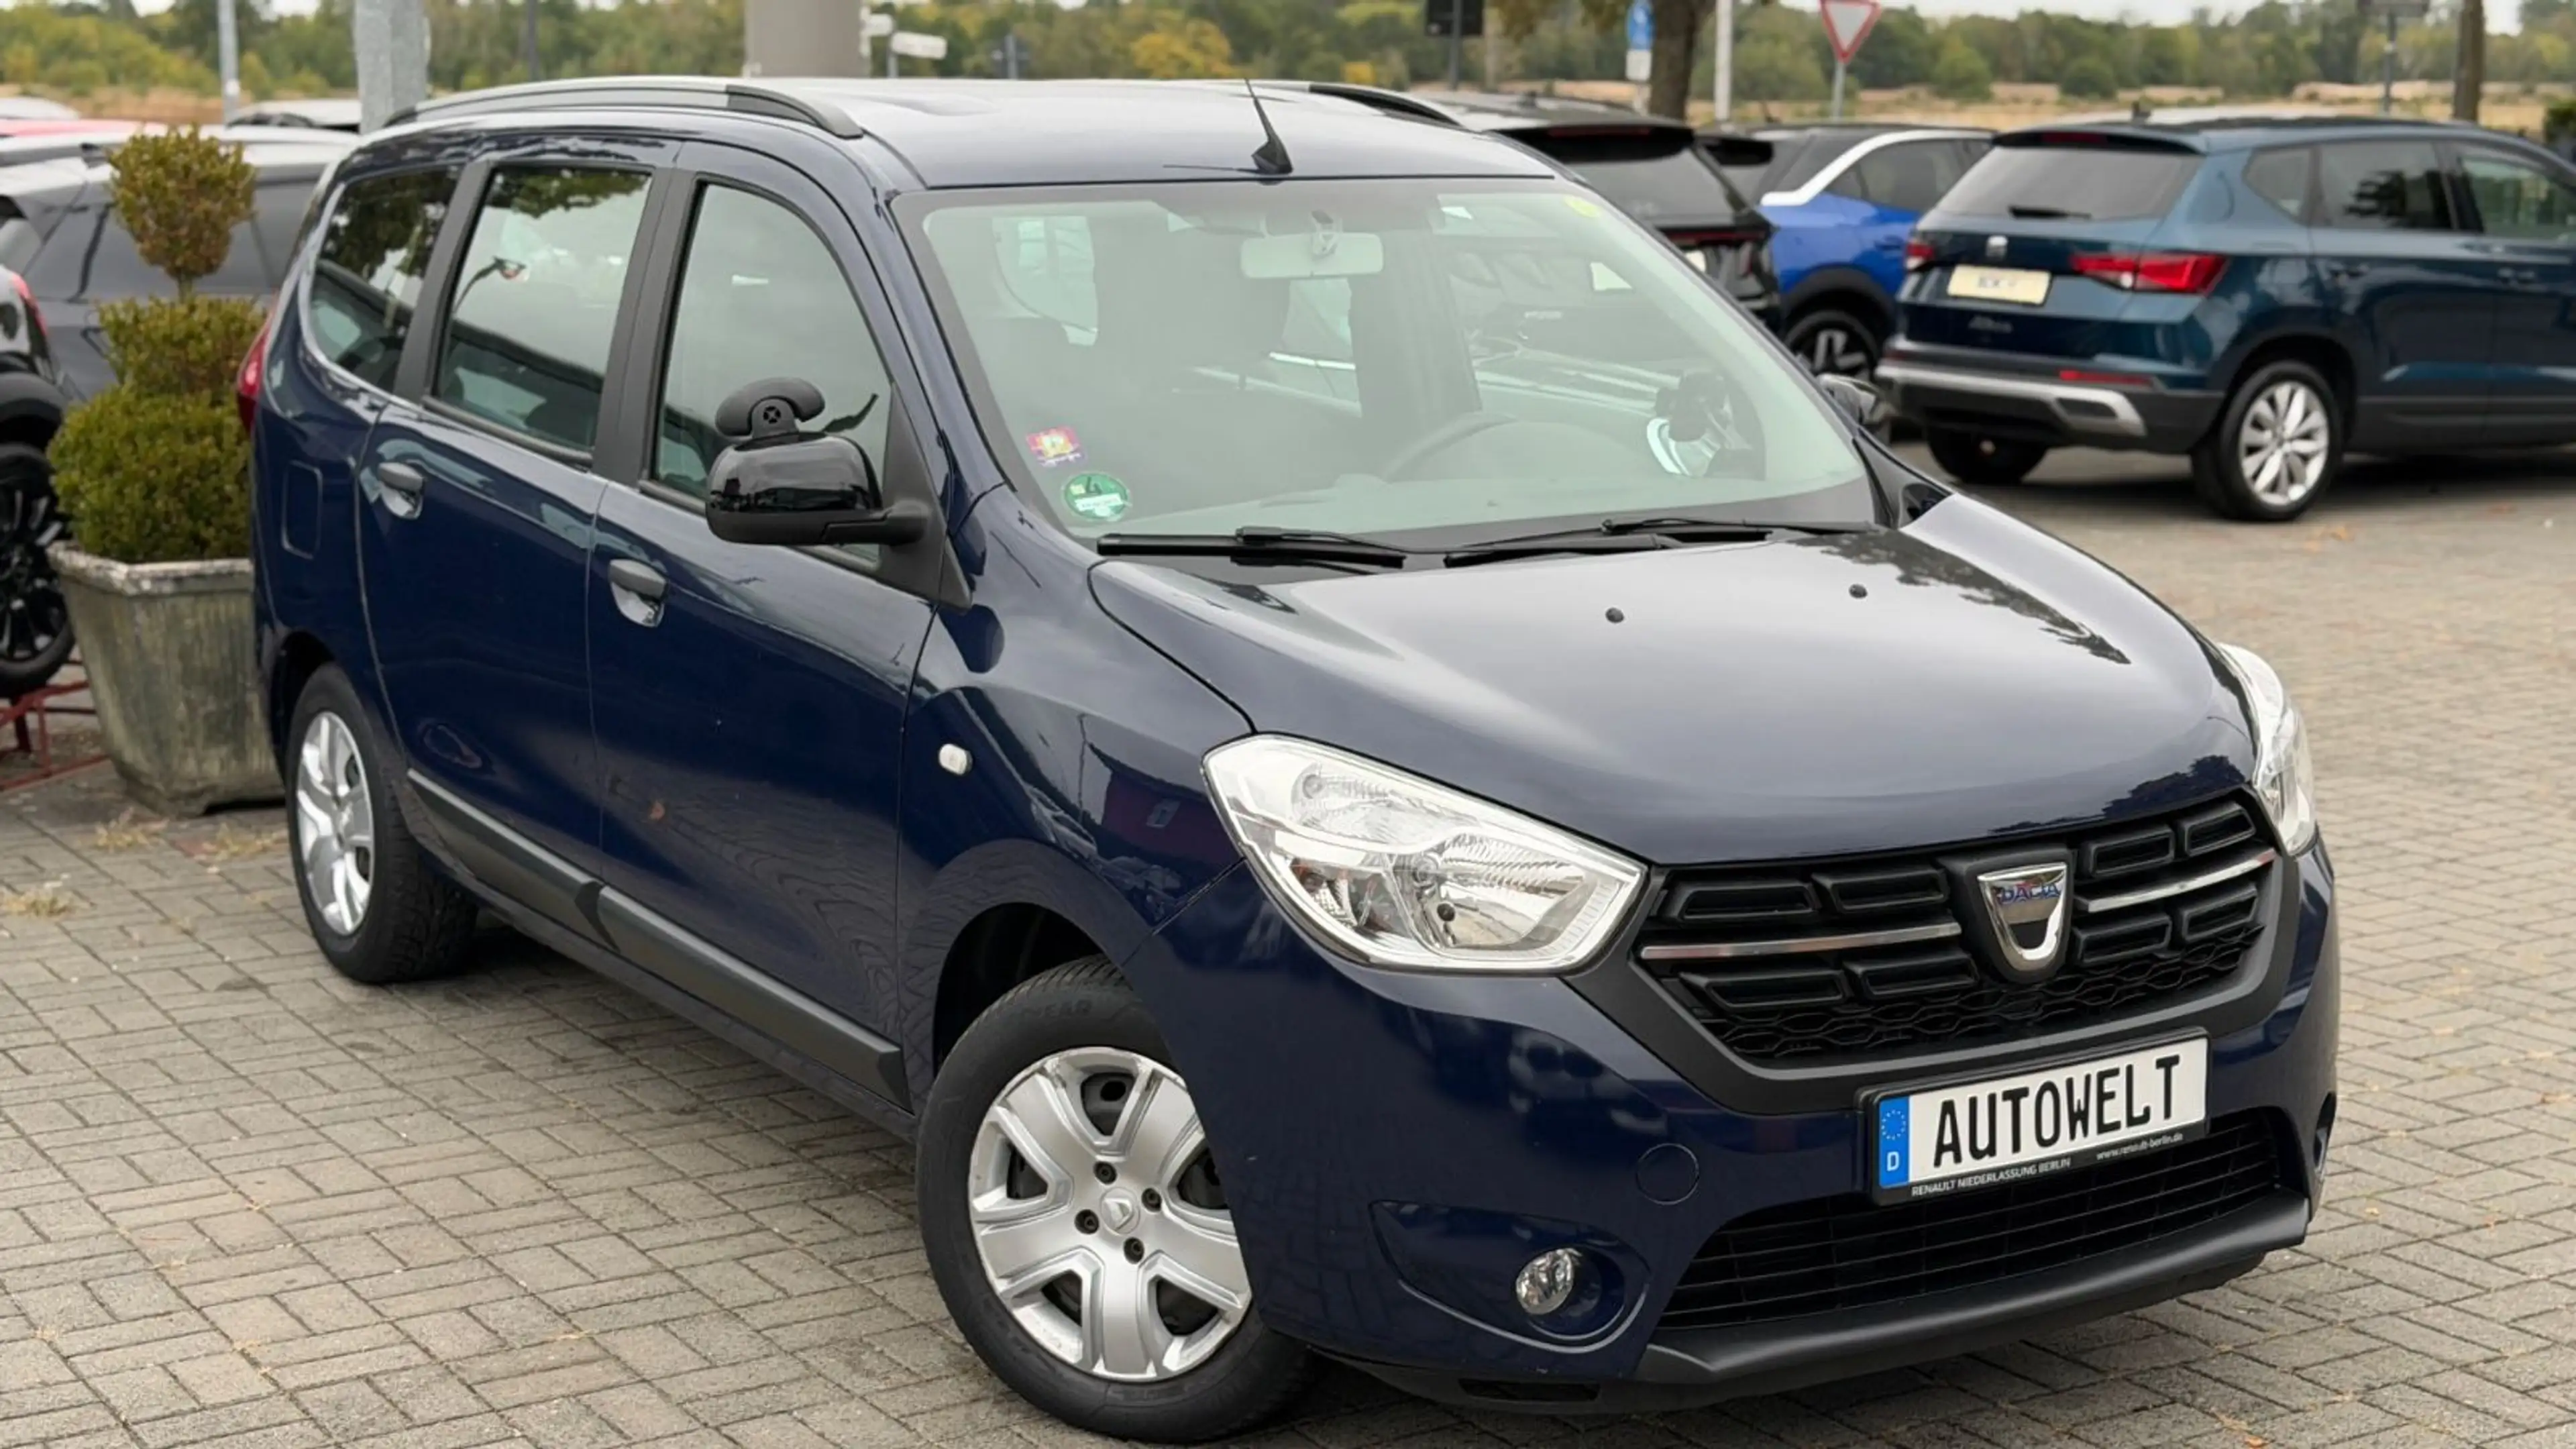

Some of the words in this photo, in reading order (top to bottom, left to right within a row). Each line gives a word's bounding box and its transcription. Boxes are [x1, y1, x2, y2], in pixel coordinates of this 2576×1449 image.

[1933, 1054, 2180, 1168] AUTOWELT
[1886, 1151, 1900, 1172] D
[1911, 1180, 1955, 1197] RENAULT
[1957, 1164, 2037, 1188] NIEDERLASSUNG
[2038, 1157, 2072, 1173] BERLIN
